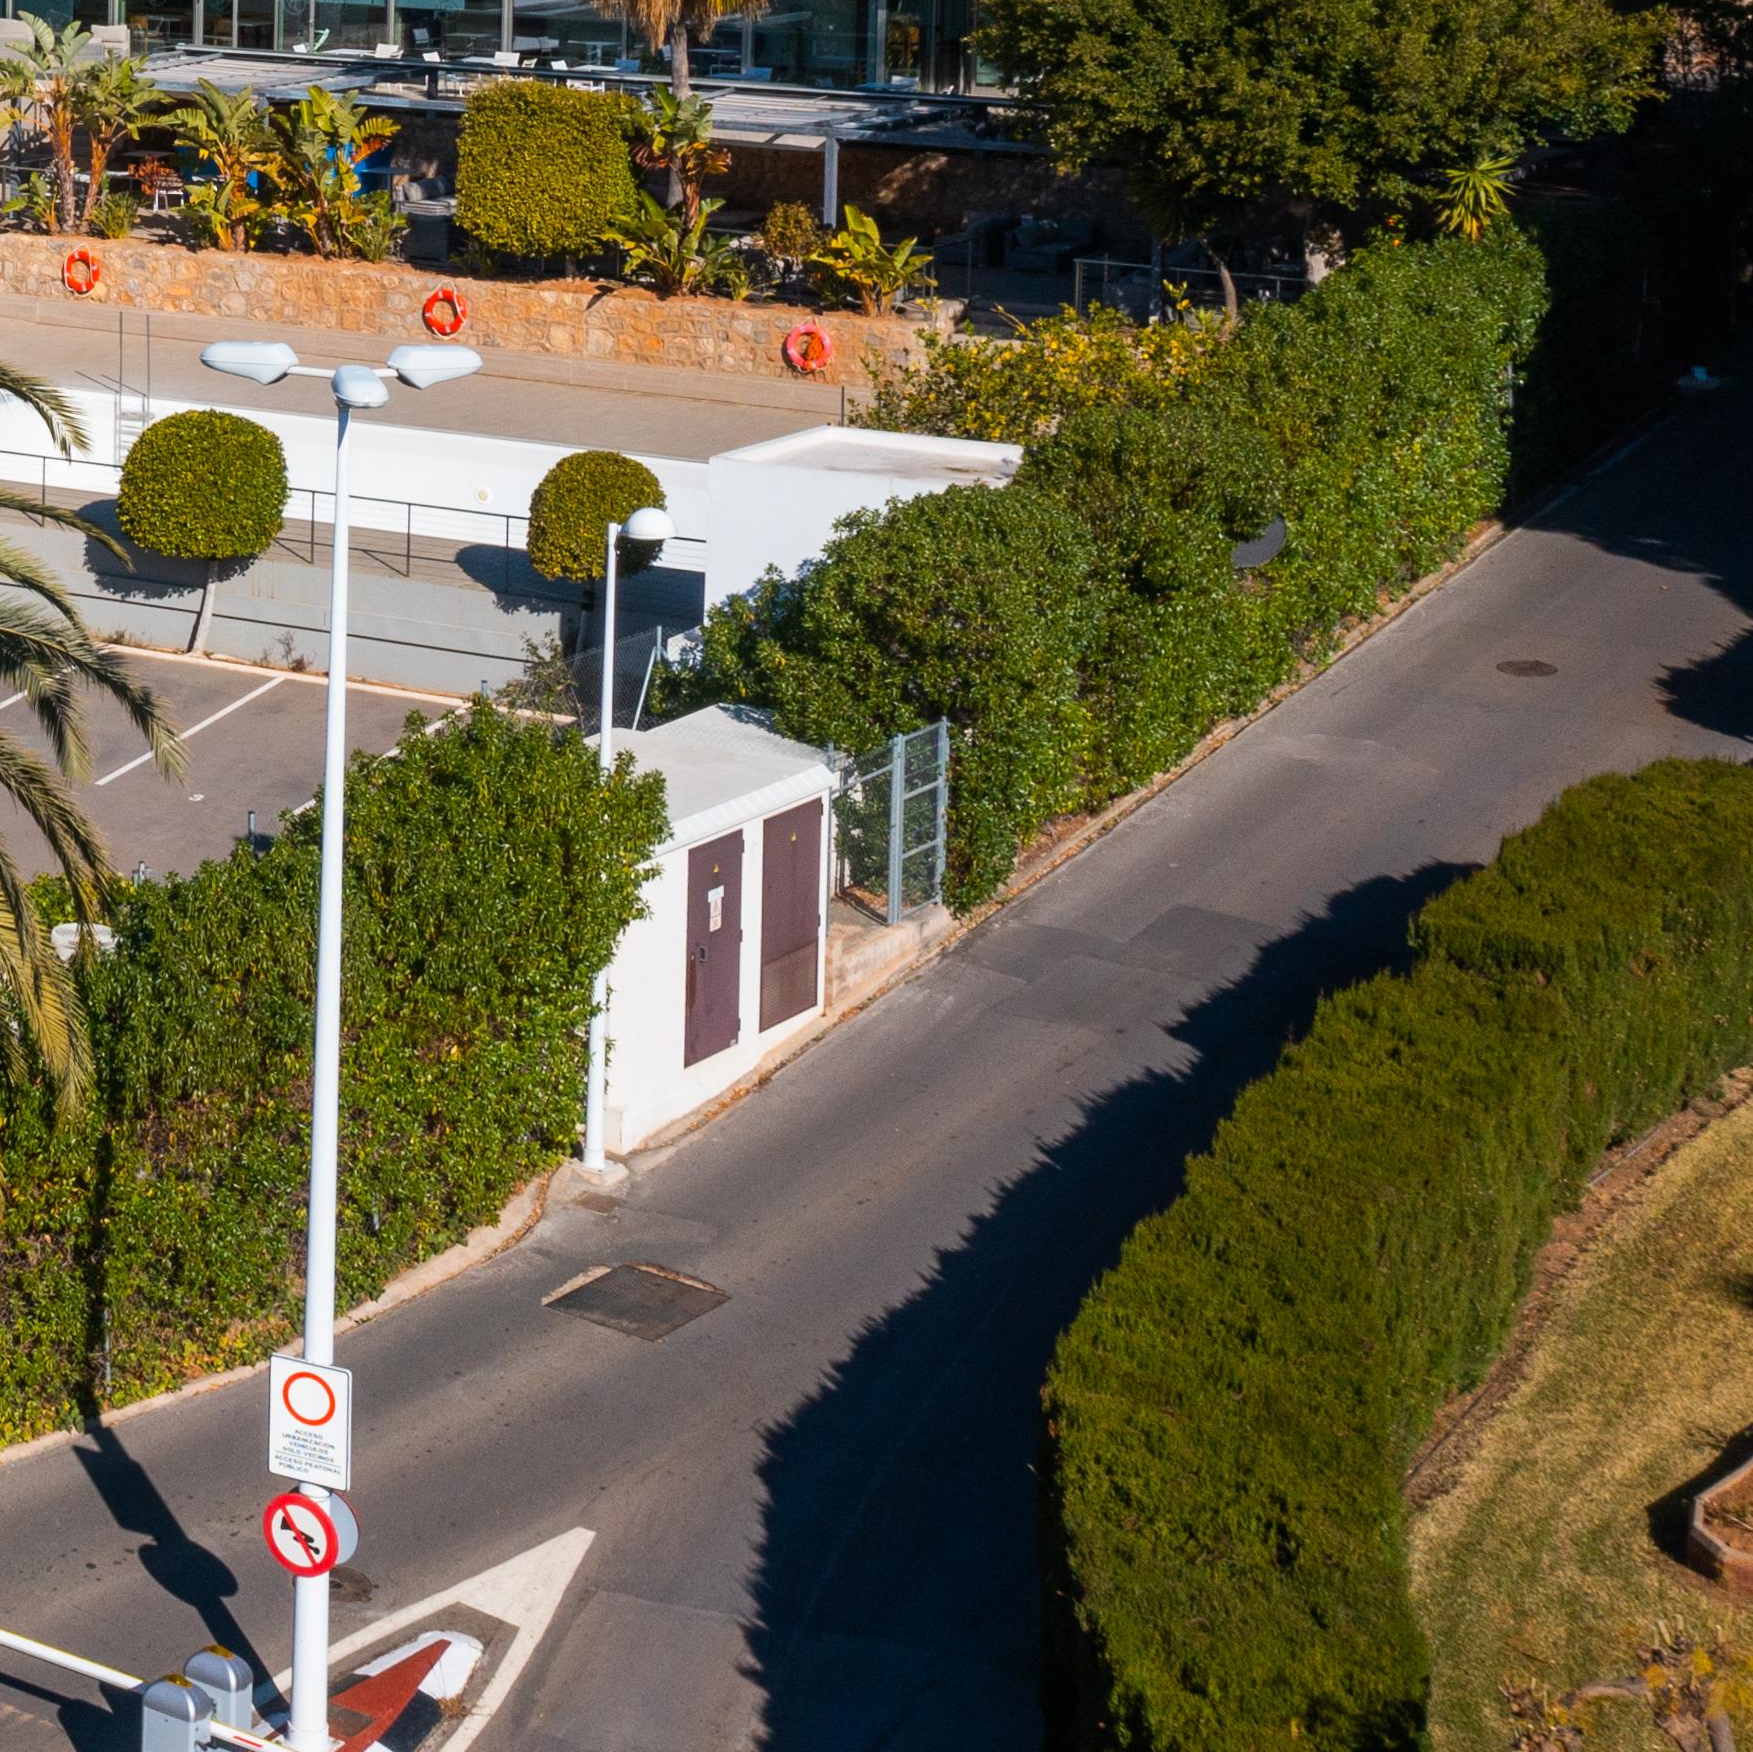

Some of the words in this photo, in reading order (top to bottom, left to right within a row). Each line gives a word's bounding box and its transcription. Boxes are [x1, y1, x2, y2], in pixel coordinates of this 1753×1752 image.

[295, 1429, 323, 1440] ACCESO
[275, 1454, 303, 1465] ACCESO
[305, 1461, 342, 1476] PEATONAL
